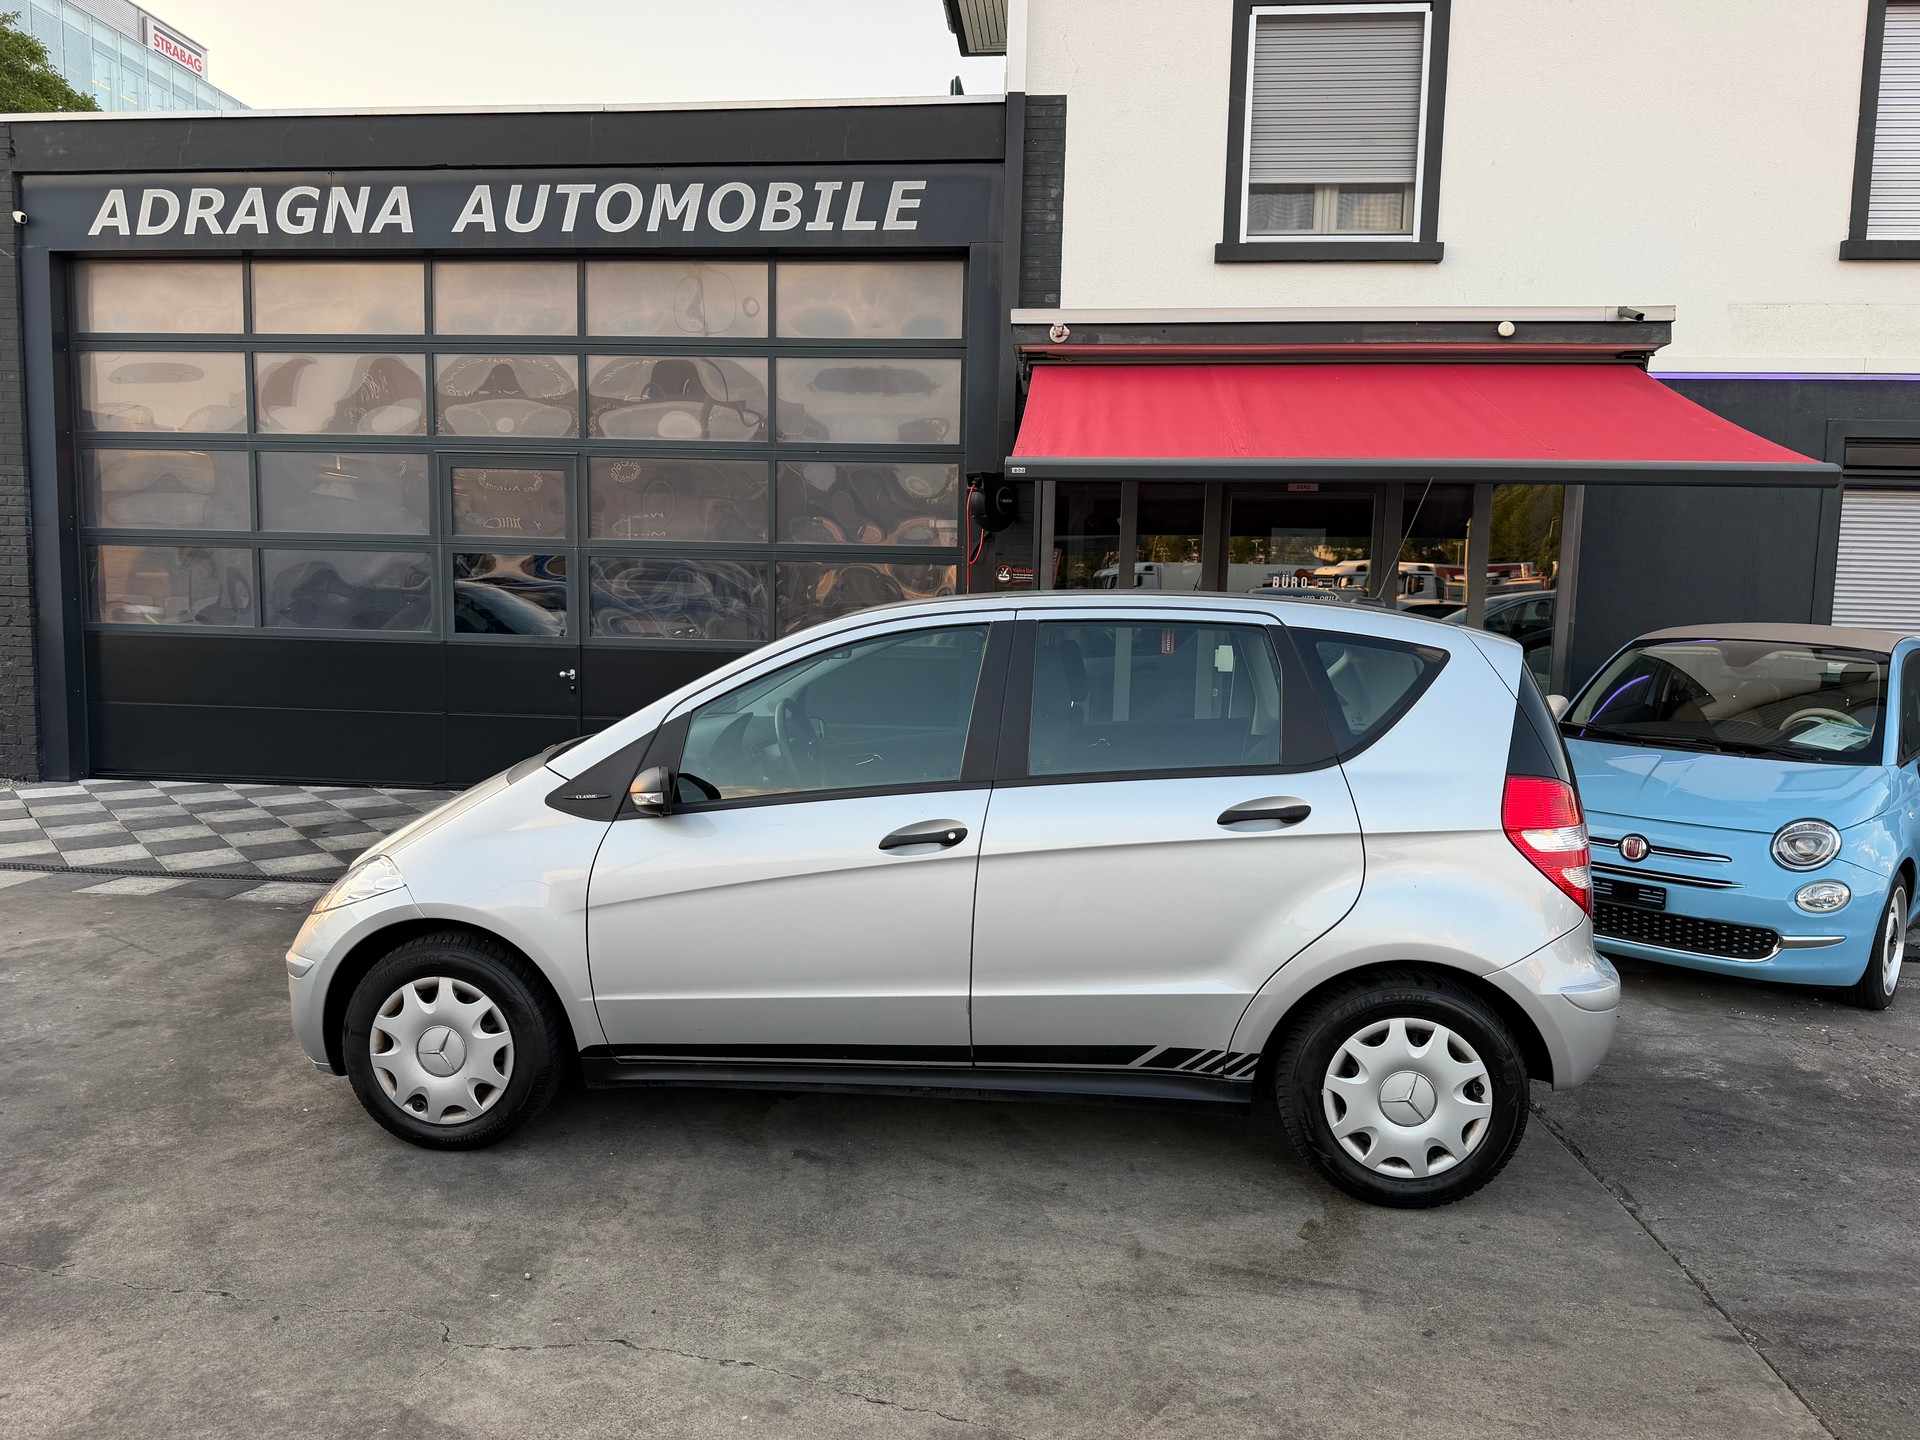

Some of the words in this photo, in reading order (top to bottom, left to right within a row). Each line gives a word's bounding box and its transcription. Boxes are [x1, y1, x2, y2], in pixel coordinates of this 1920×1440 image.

[153, 33, 202, 72] STRABAG
[87, 186, 414, 236] ADRAGNA
[451, 180, 927, 233] AUTOMOBILE
[1272, 574, 1308, 588] BÜRO
